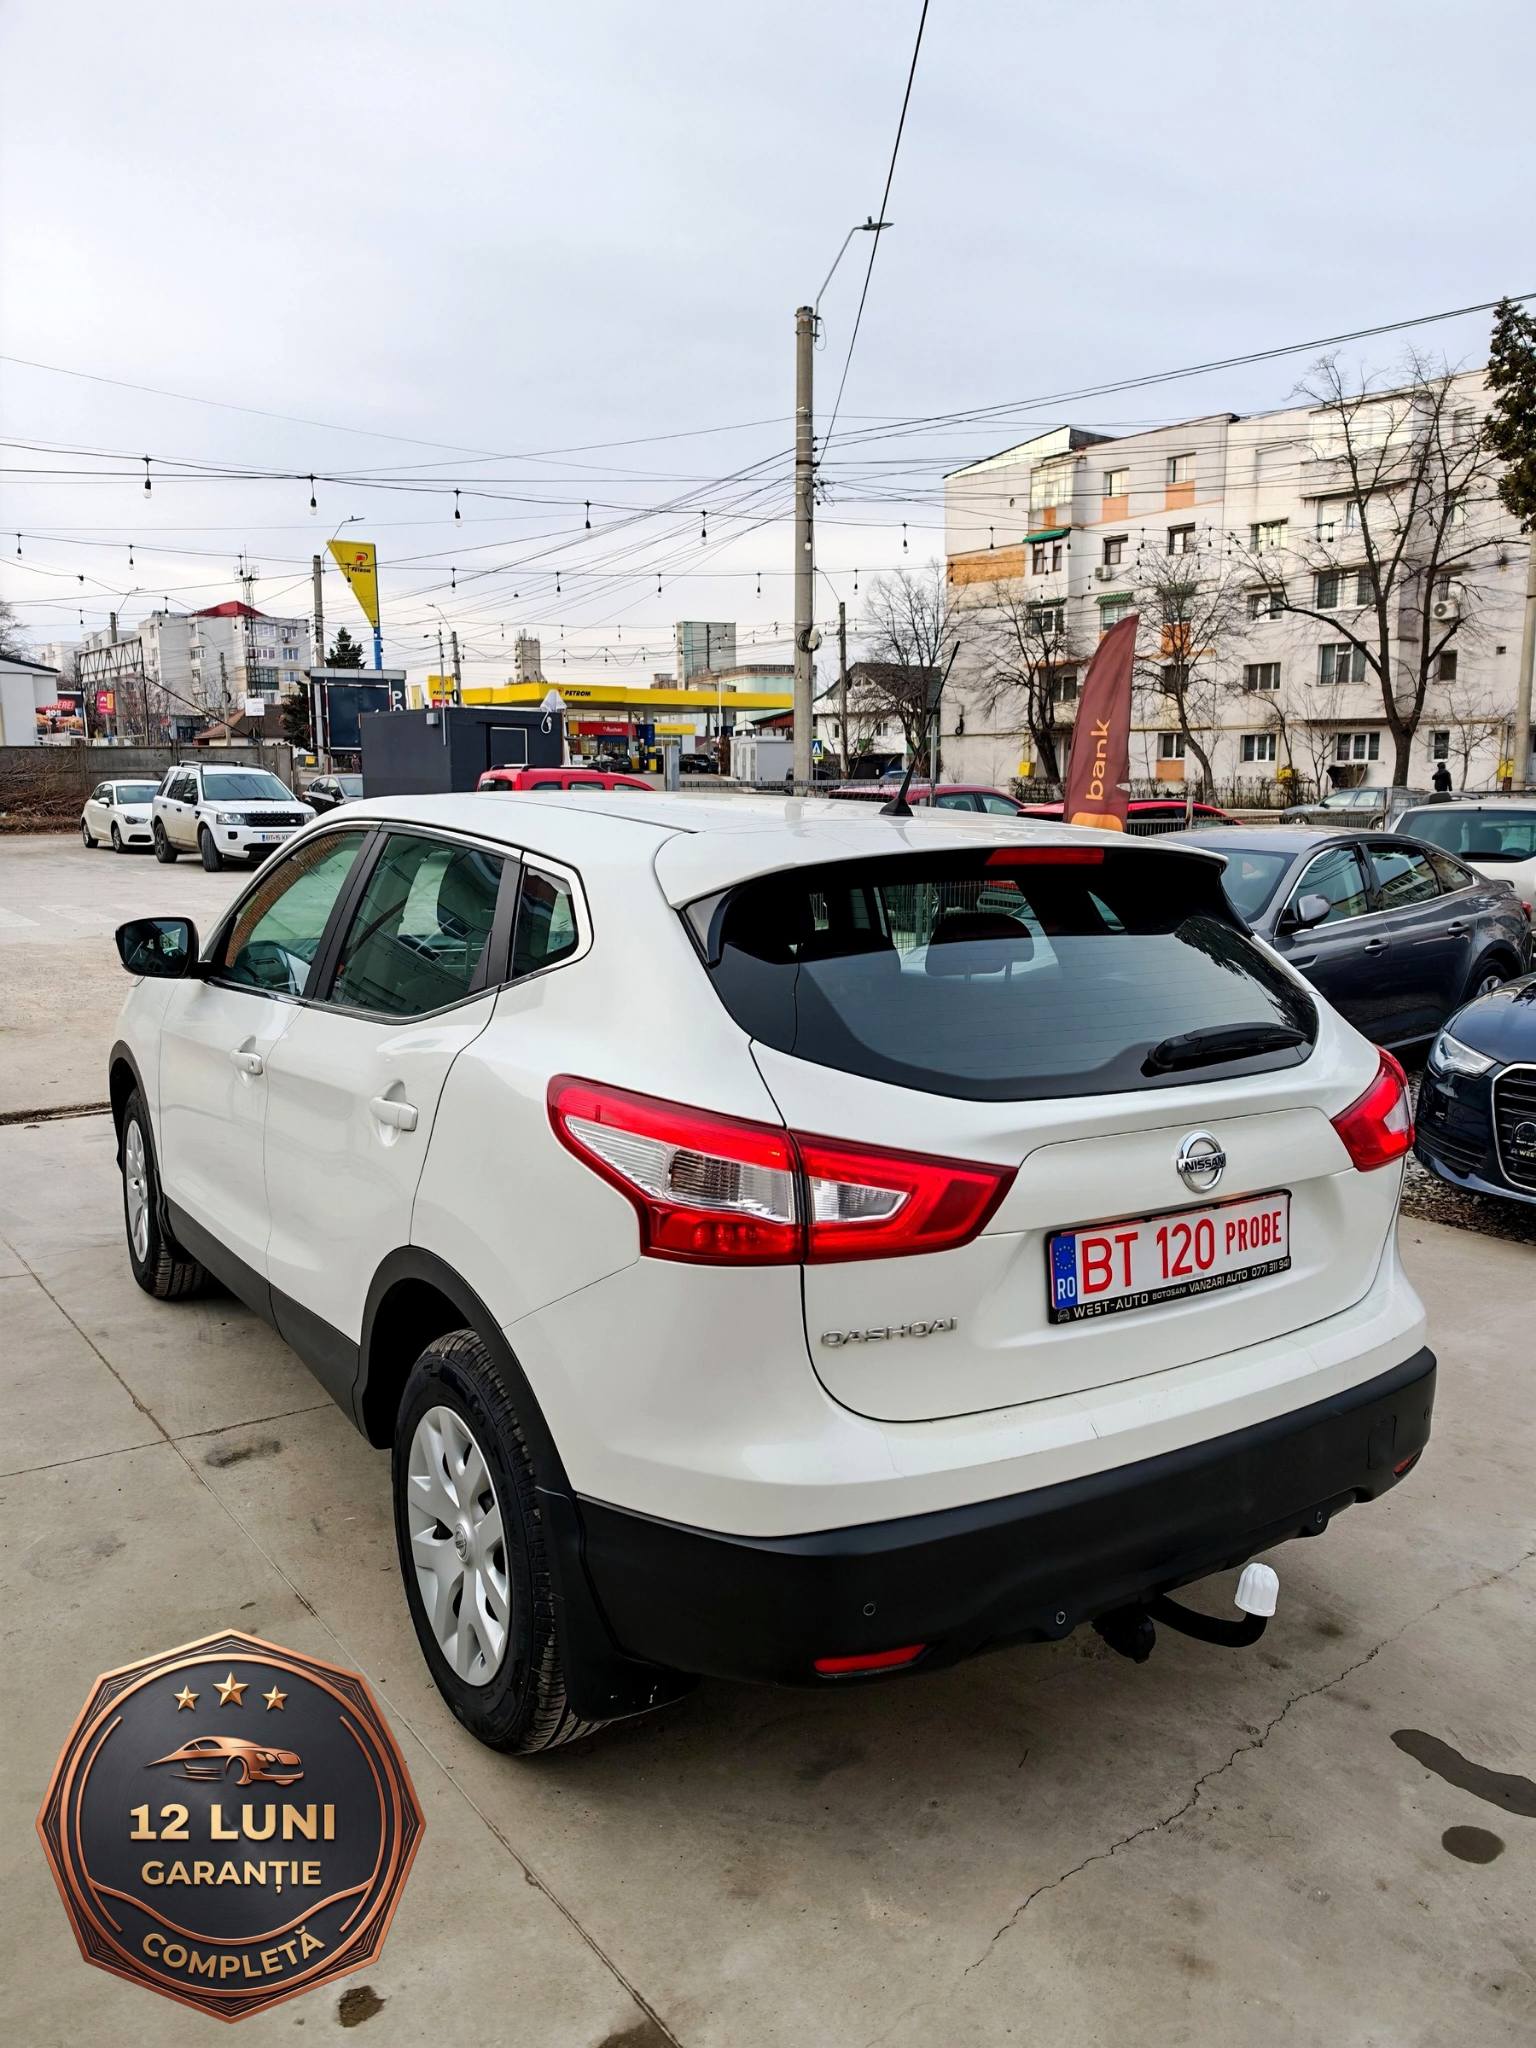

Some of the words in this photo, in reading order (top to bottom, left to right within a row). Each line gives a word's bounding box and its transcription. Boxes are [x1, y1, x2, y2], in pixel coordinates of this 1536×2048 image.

[1085, 719, 1111, 800] bank
[1184, 1156, 1224, 1170] NISSAN
[1081, 1231, 1138, 1294] BT
[1156, 1218, 1215, 1279] 120
[1225, 1211, 1282, 1255] PROBE
[1057, 1276, 1076, 1300] RO
[1073, 1293, 1149, 1318] WEST-AUTO
[1152, 1286, 1187, 1300] BOTOSANI
[1188, 1278, 1225, 1293] VANZARI
[1226, 1269, 1248, 1283] AUTO
[821, 1316, 958, 1347] QASHQAI
